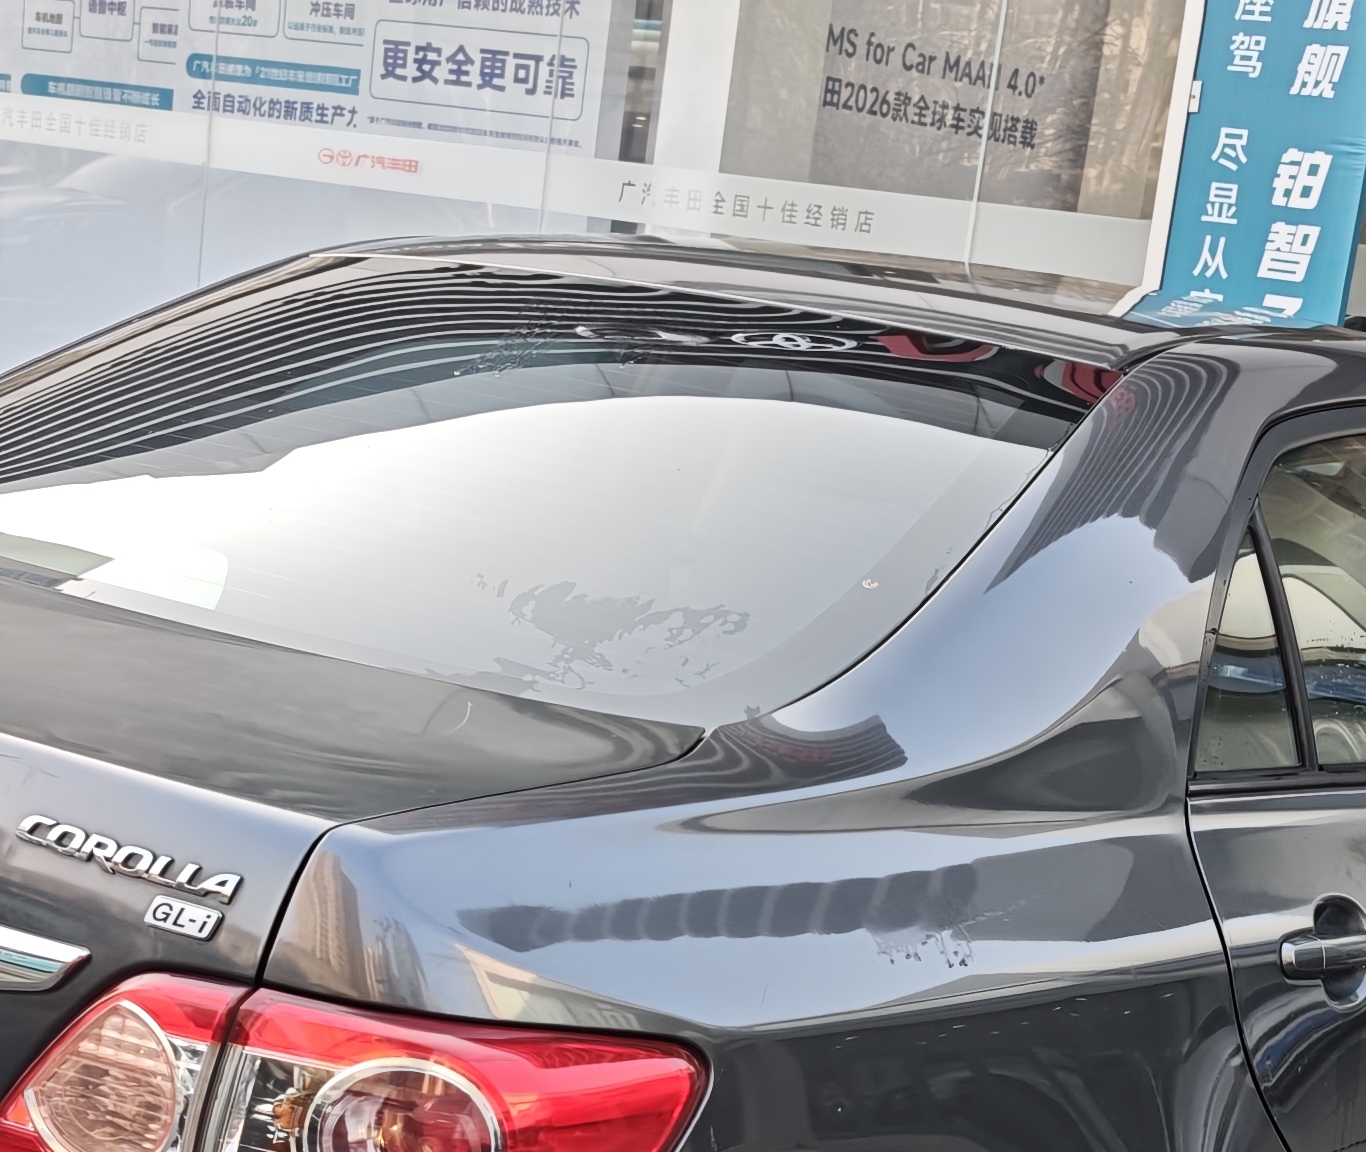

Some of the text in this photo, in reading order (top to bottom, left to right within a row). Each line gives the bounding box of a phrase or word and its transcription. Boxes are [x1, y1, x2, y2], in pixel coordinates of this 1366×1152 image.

[379, 38, 578, 100] 更安全更可靠
[826, 23, 859, 59] MS
[865, 31, 895, 67] for
[901, 41, 937, 77] Car
[354, 154, 419, 174] 广汽丰田
[15, 814, 244, 905] COROLLA
[151, 901, 213, 935] GL-i
